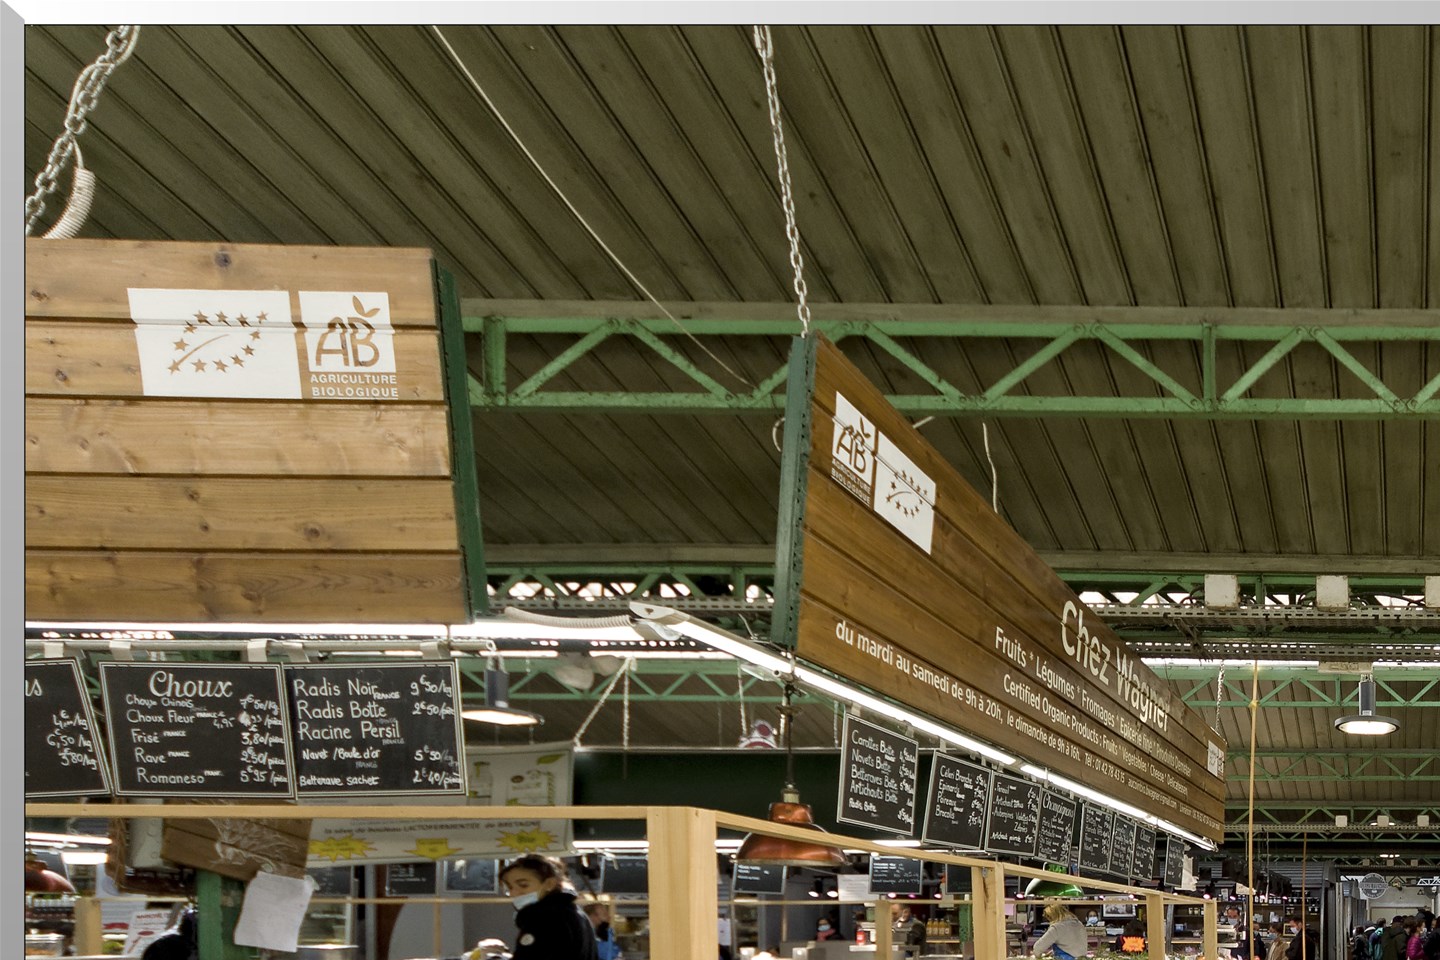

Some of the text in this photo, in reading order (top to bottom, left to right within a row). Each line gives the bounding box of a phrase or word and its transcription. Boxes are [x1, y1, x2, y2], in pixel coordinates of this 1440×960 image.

[316, 316, 380, 367] AB
[310, 373, 397, 384] AGRICULTURE
[311, 386, 399, 397] BIOLOGIQUE
[836, 424, 866, 474] AB
[995, 626, 1027, 668] Fruits
[1036, 656, 1075, 700] Légumes
[1082, 689, 1115, 728] Fromages
[1062, 600, 1170, 732] Chez Wagner
[149, 670, 233, 698] Choux
[293, 677, 341, 697] Radis
[347, 678, 379, 696] Noir
[836, 620, 853, 645] du
[857, 633, 893, 665] mardi
[896, 654, 910, 674] au
[912, 663, 949, 694] samedi
[951, 683, 963, 701] de
[965, 690, 977, 711] 9h
[978, 696, 984, 711] à
[1006, 710, 1014, 727] le
[1015, 716, 1047, 744] dimanche
[1048, 733, 1057, 748] de
[1057, 738, 1065, 753] 9h
[126, 709, 164, 723] Choux
[167, 709, 195, 723] Fleur
[296, 700, 387, 719] Radis Botte
[1003, 673, 1041, 711] Certified
[1042, 697, 1071, 728] Organic
[1071, 714, 1099, 745] Products
[1102, 734, 1118, 755] Fruits
[297, 721, 352, 740] Racine
[361, 720, 400, 739] Persil
[851, 729, 879, 752] Carottes
[134, 747, 167, 764] Rave
